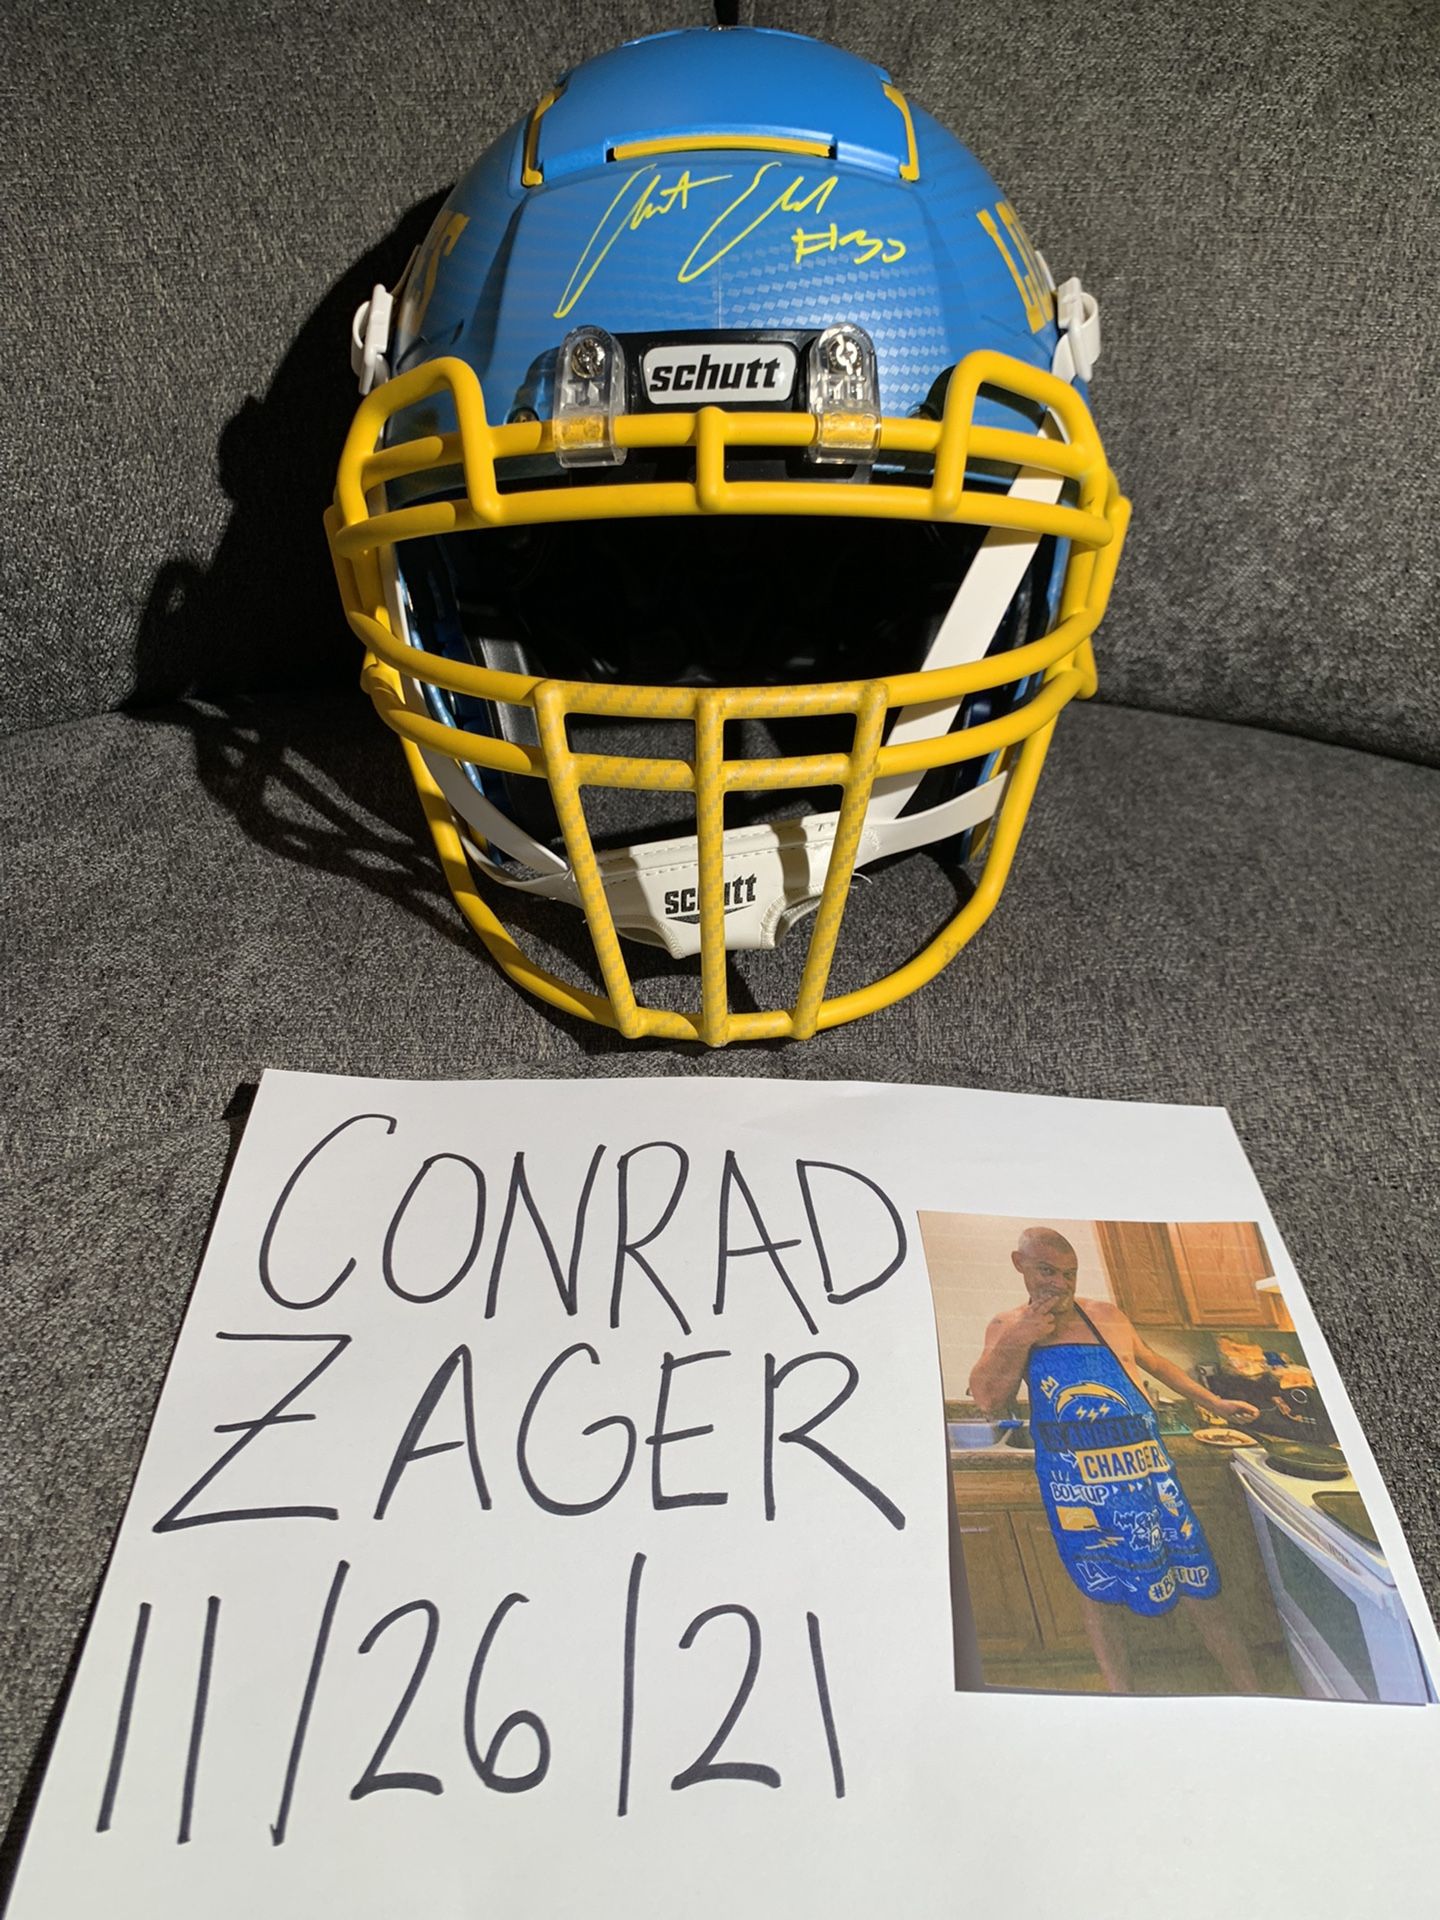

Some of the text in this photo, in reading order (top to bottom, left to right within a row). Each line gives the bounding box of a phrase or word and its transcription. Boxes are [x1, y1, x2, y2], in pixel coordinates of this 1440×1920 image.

[649, 354, 780, 392] schutt
[258, 1113, 907, 1335] CONRAD
[152, 1333, 906, 1533] ZAGER
[96, 1552, 847, 1847] 11/26/21
